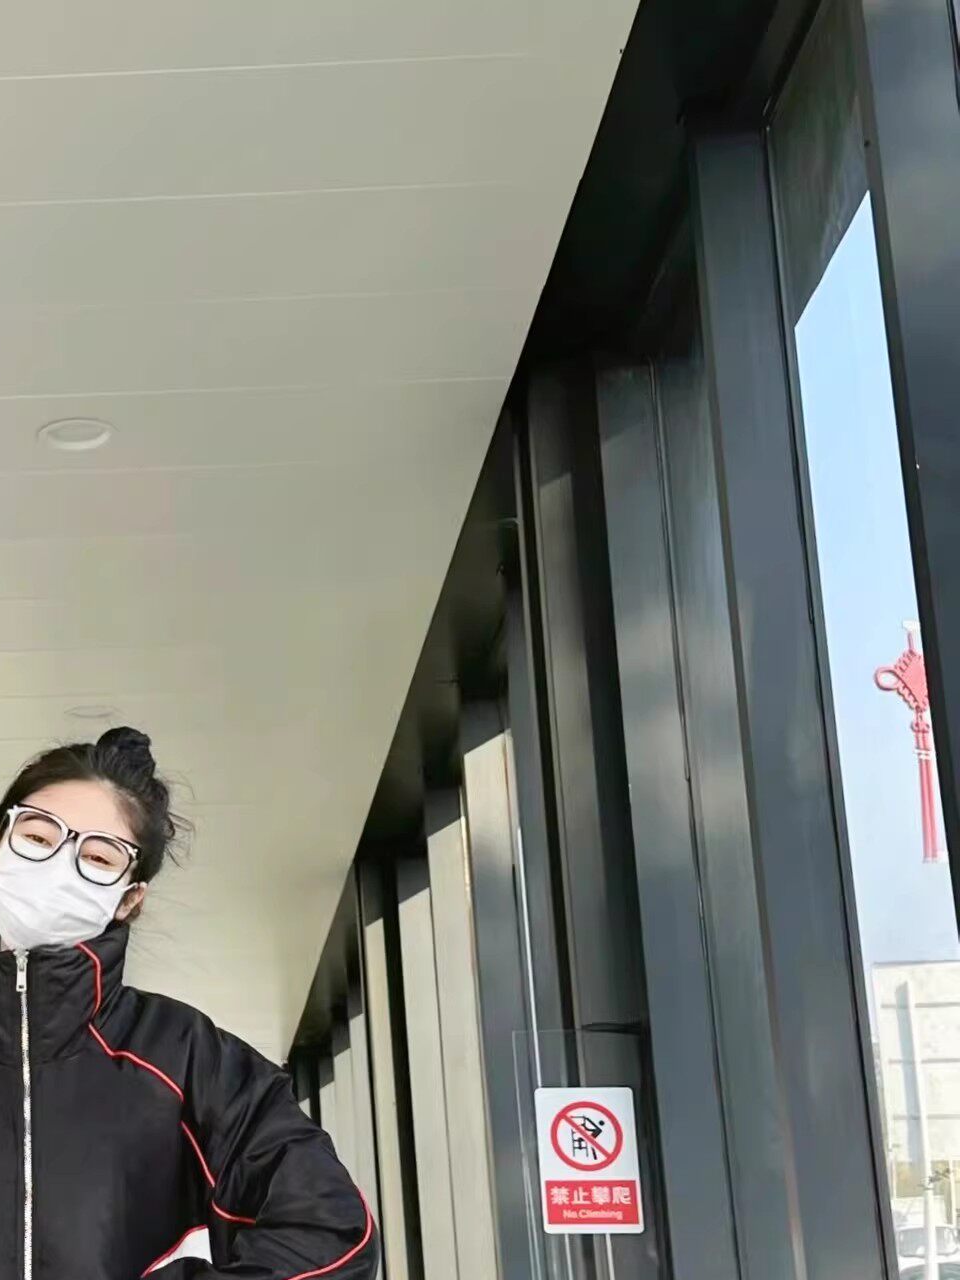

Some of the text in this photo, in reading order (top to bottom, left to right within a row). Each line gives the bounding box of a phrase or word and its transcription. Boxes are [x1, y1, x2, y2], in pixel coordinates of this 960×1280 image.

[550, 1186, 632, 1205] 禁止攀爬
[563, 1208, 624, 1221] No Climbing
